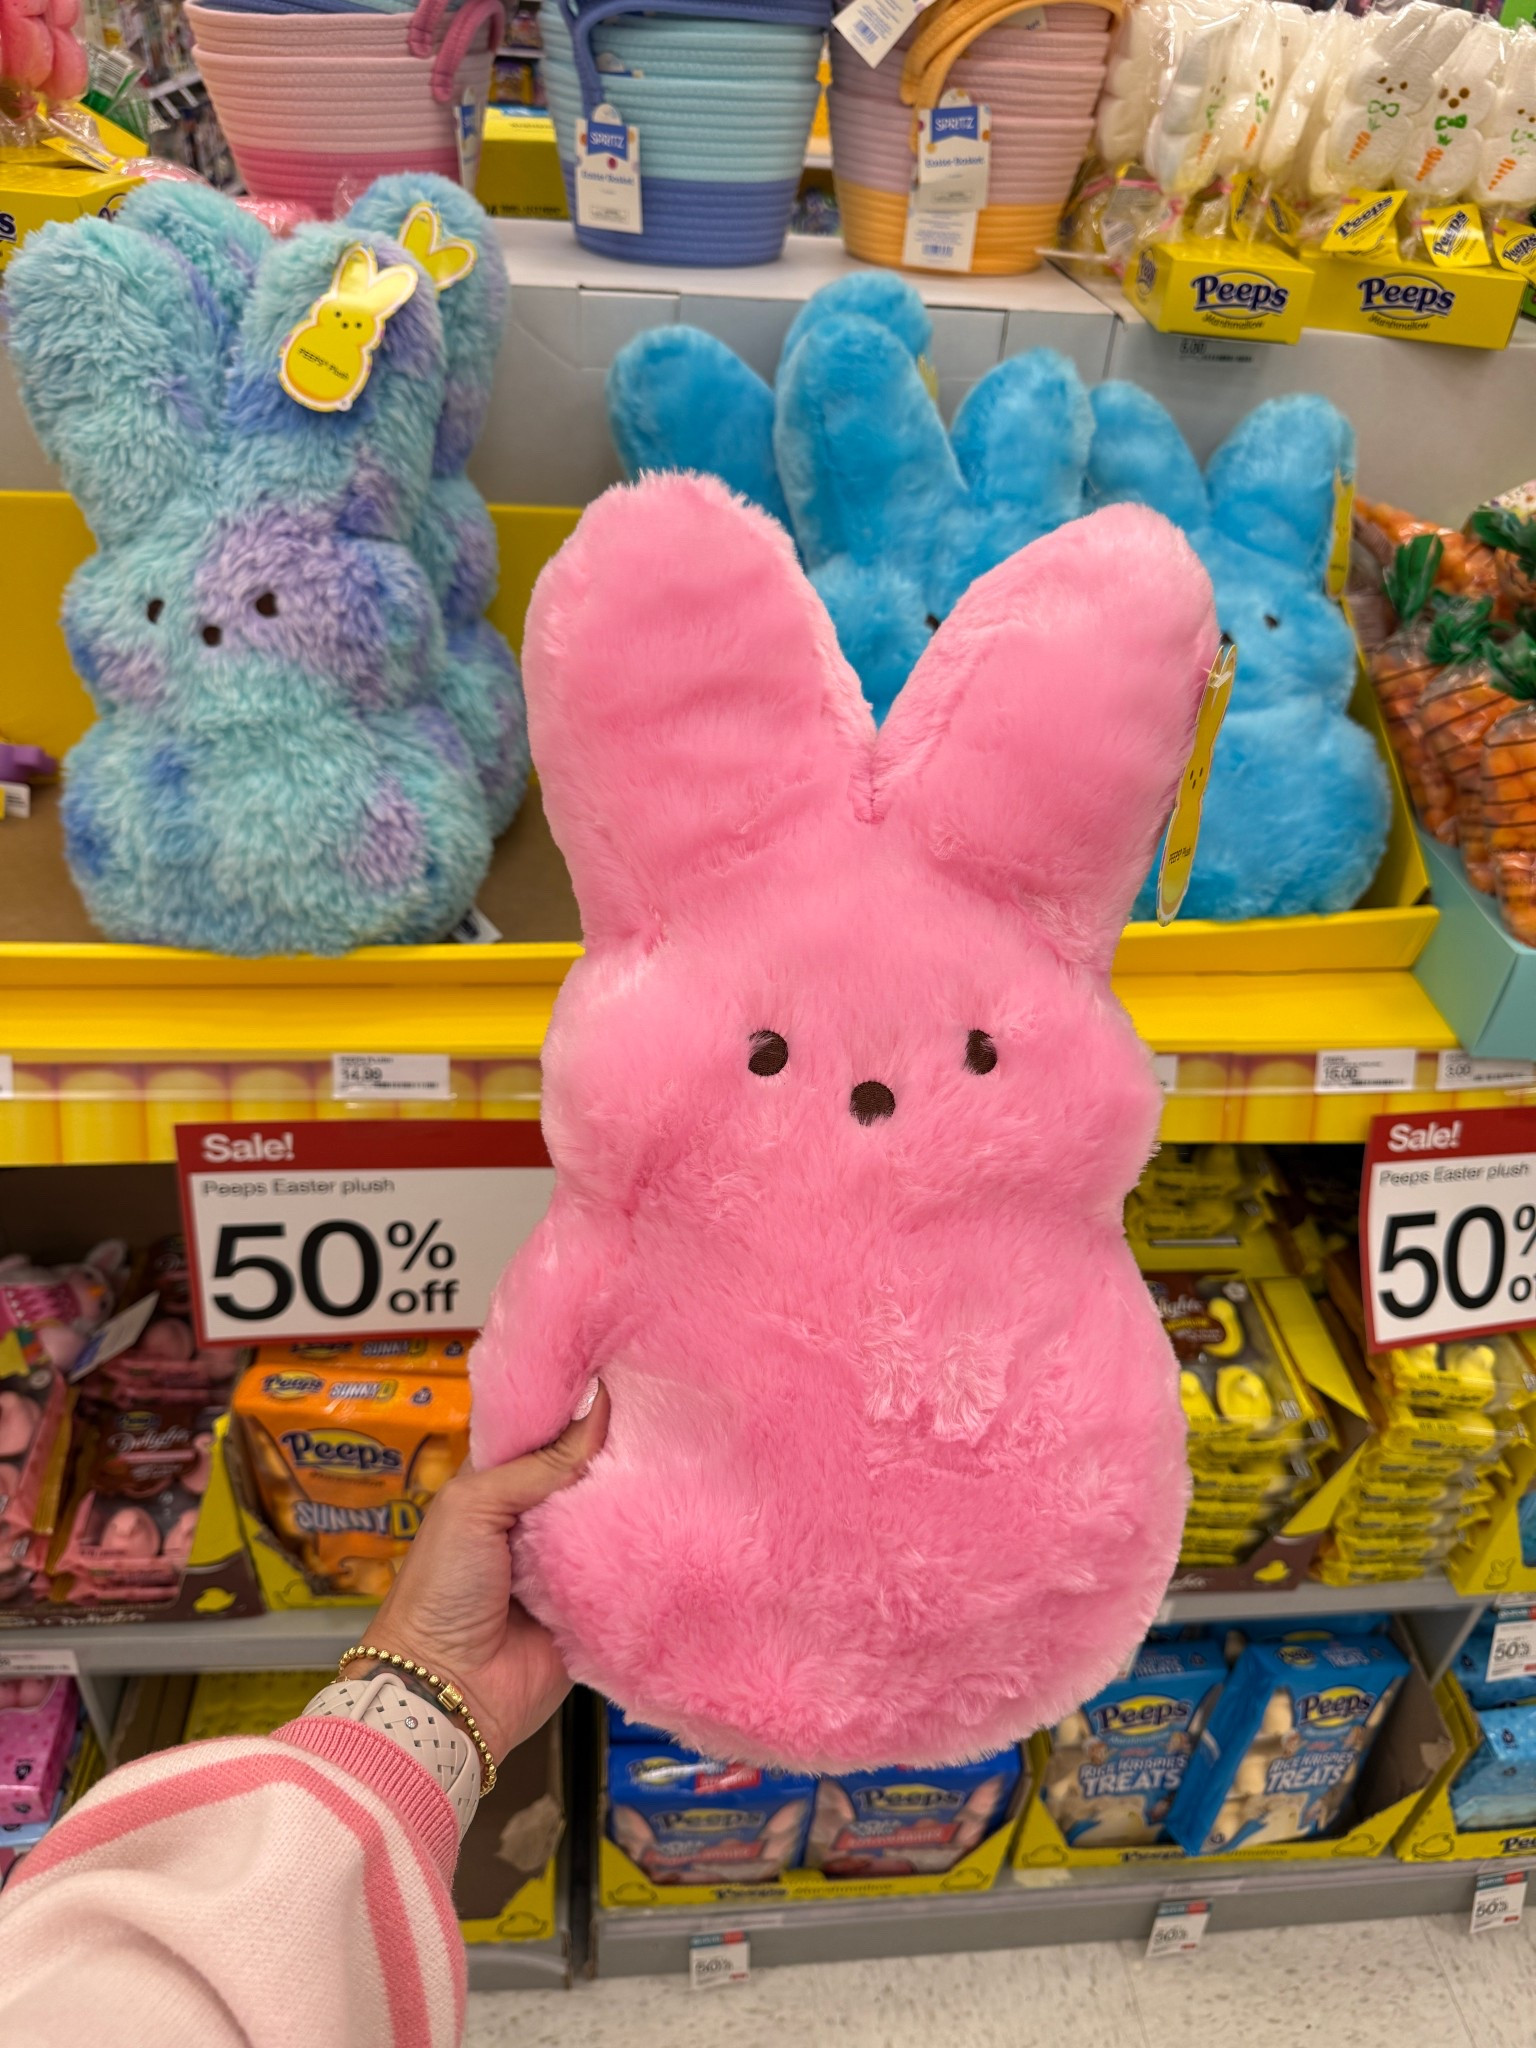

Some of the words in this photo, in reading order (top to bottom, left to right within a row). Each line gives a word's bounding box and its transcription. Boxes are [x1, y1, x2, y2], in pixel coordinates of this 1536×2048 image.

[1335, 195, 1394, 240] Peeps
[1190, 273, 1291, 312] Peeps
[1357, 276, 1456, 314] Peeps
[202, 1132, 296, 1164] Sale!
[1387, 1120, 1462, 1152] Sale!
[203, 1180, 268, 1198] Peeps
[272, 1178, 335, 1195] Easter
[342, 1177, 396, 1198] plush
[1380, 1169, 1429, 1187] Peeps
[1434, 1164, 1484, 1183] Easter
[1487, 1161, 1530, 1181] plush
[388, 1279, 460, 1315] off
[280, 1430, 404, 1473] Peeps
[296, 1500, 425, 1541] SUNNYD
[1095, 1701, 1190, 1734] Peeps
[1299, 1694, 1374, 1725] Peeps
[1083, 1767, 1182, 1797] TREATS
[1266, 1765, 1347, 1793] TREATS
[856, 1787, 965, 1810] Peeps
